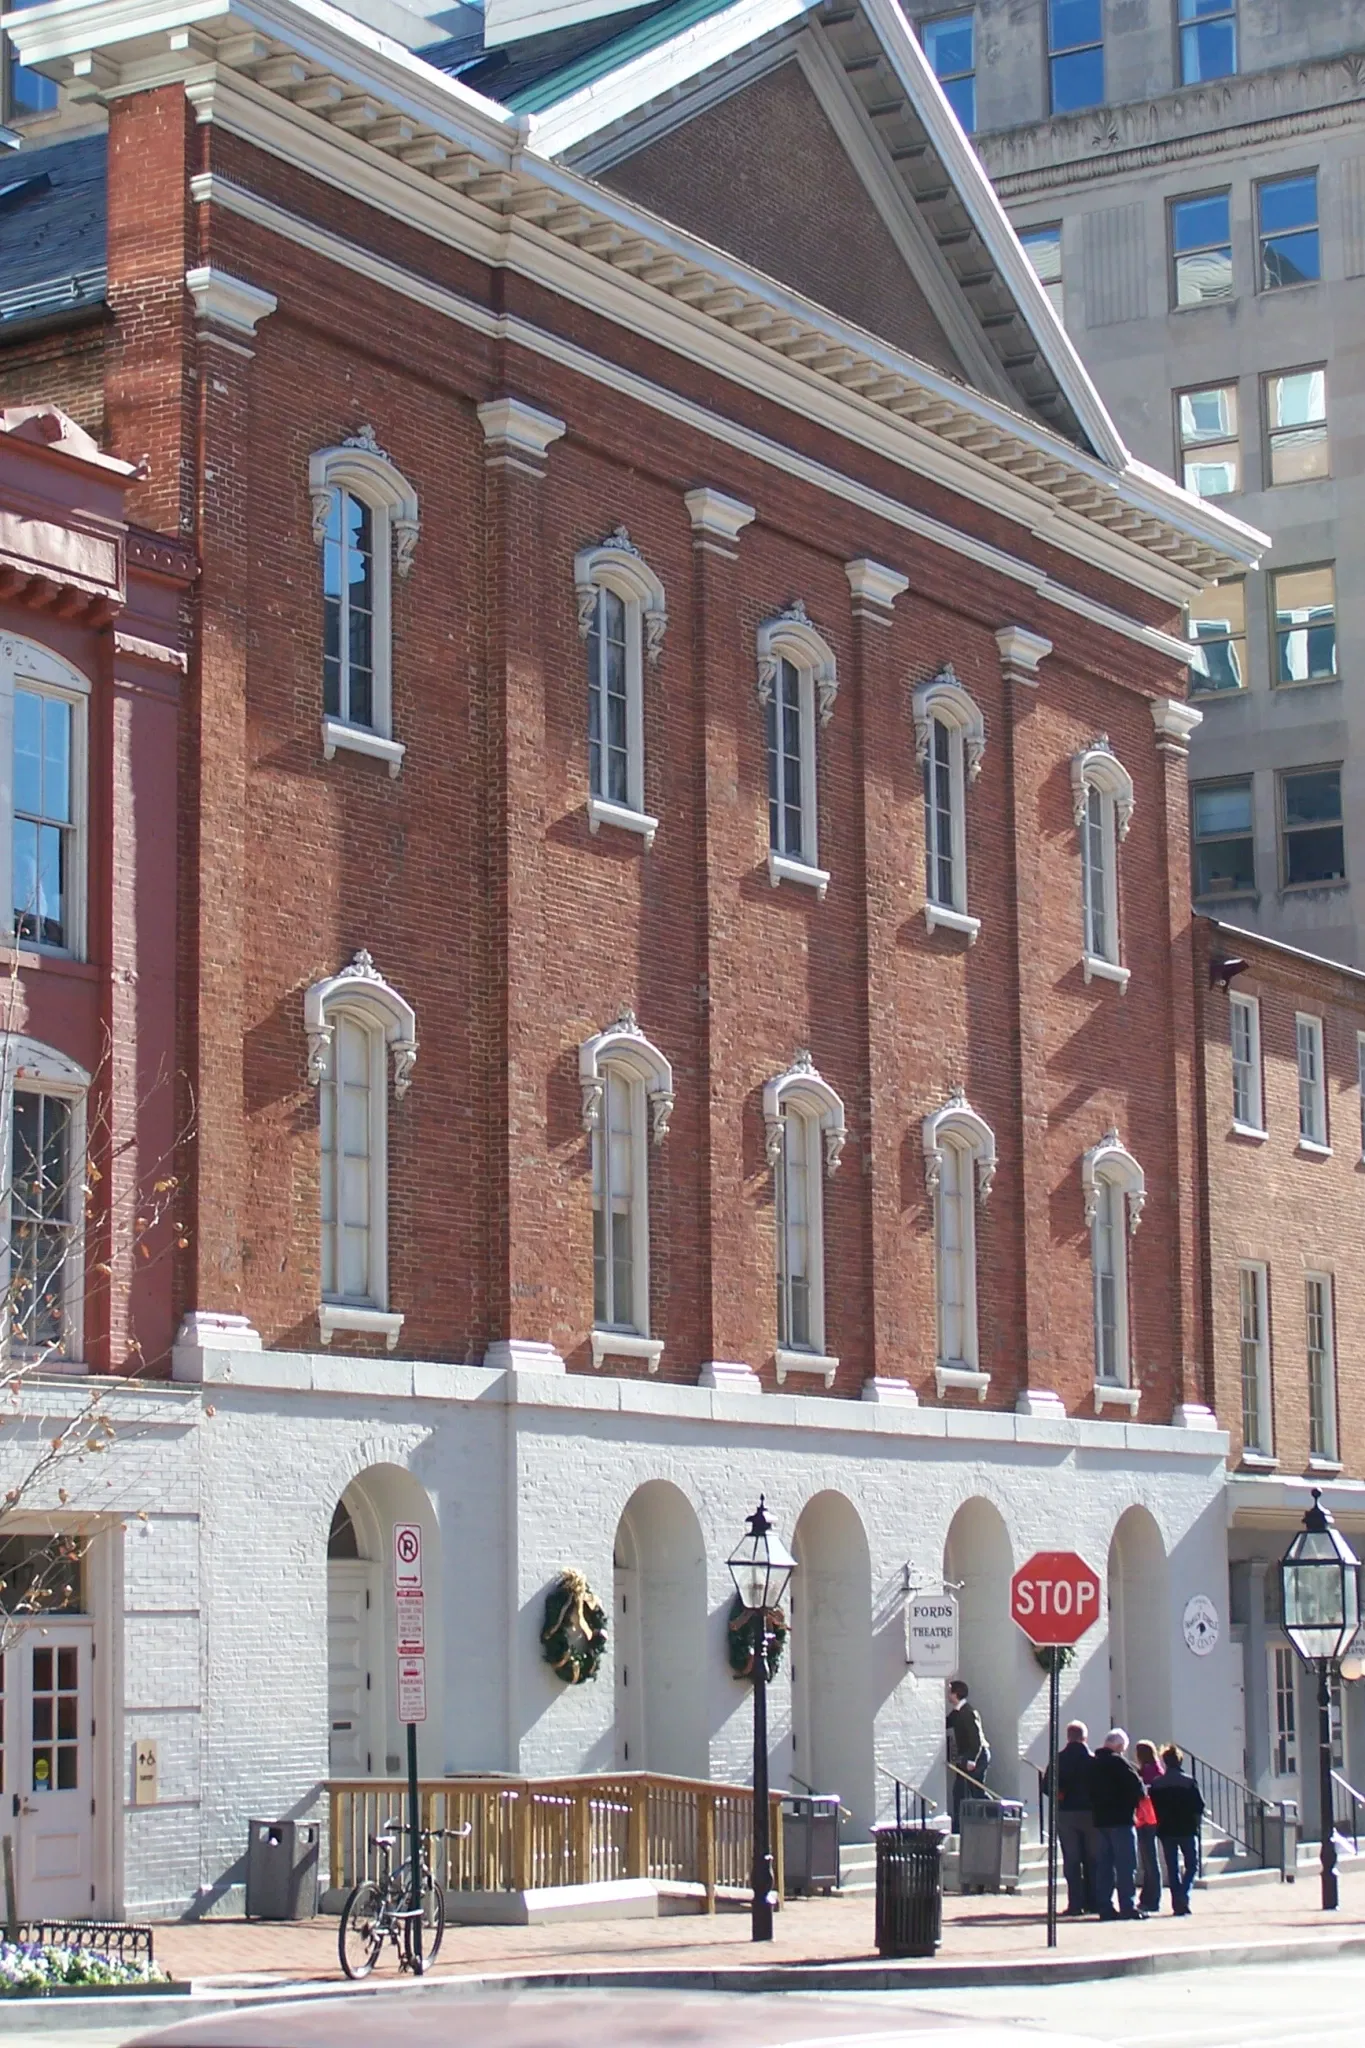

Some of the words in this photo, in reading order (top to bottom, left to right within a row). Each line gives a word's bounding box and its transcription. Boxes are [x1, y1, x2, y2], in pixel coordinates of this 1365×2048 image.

[1016, 1580, 1095, 1615] STOP
[914, 1604, 953, 1618] FORD'S
[913, 1627, 953, 1638] THEATRE
